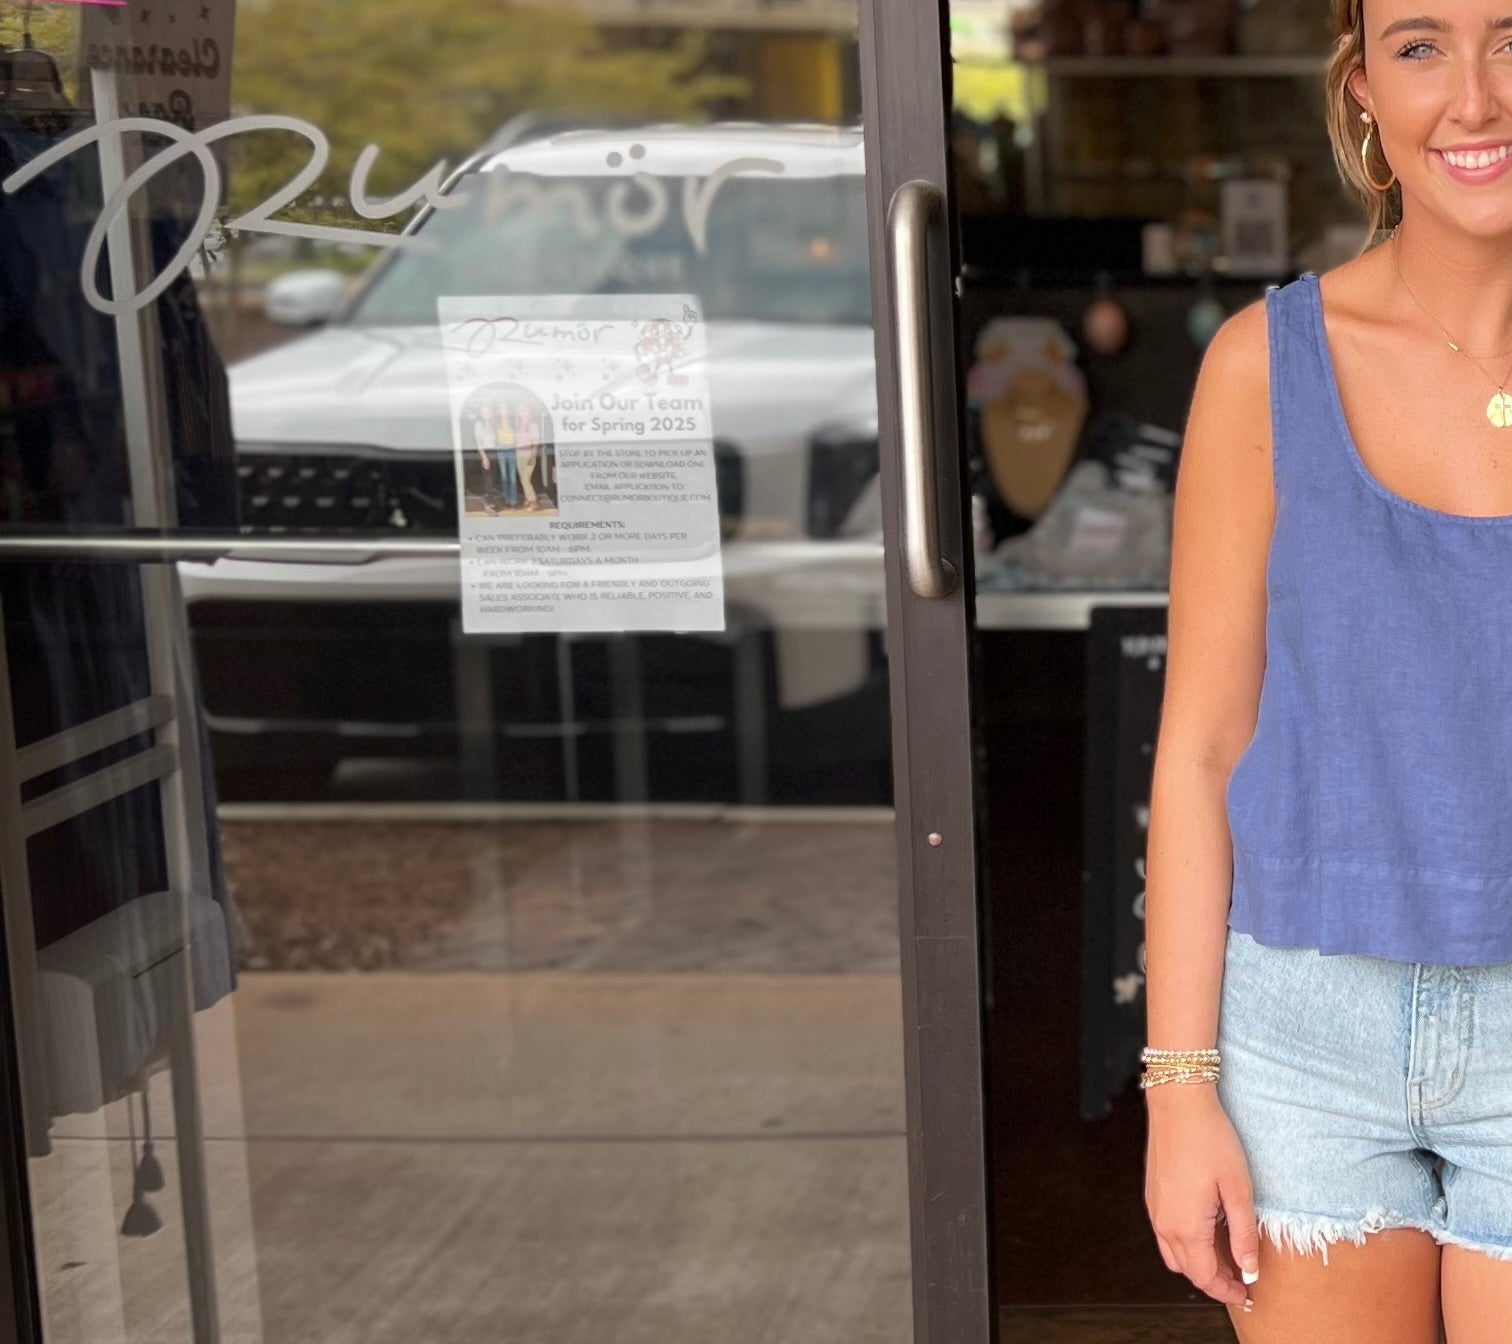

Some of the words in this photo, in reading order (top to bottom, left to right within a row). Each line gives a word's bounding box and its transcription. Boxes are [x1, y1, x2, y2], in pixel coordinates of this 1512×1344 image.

[3, 114, 786, 316] Rumör
[450, 315, 616, 359] Rumör
[551, 394, 594, 412] Join
[599, 392, 639, 412] Our
[645, 392, 703, 411] Team
[562, 417, 585, 432] for
[591, 417, 645, 436] Spring
[650, 417, 697, 432] 2025
[559, 449, 582, 457] STOP
[583, 449, 594, 457] BY
[597, 449, 613, 457] THE
[616, 449, 641, 457] STORE
[644, 449, 656, 457] TO
[658, 449, 679, 457] PICK
[680, 449, 693, 457] UP
[694, 449, 707, 457] AN
[561, 460, 618, 468] APPLICATION
[620, 460, 633, 468] OR
[634, 460, 686, 468] DOWNLOAD
[687, 460, 705, 468] ONE
[590, 471, 617, 479] FROM
[618, 471, 638, 479] OUR
[584, 483, 611, 491] EMAIL
[613, 483, 670, 491] APPLICATION
[549, 521, 626, 529] REQUIREMENTS:
[475, 534, 495, 542] CAN
[497, 534, 556, 542] PREFERABLY
[559, 533, 588, 541] WORK
[598, 533, 612, 541] OR
[614, 532, 640, 540] MORE
[644, 532, 668, 540] DAYS
[670, 532, 688, 540] PER
[476, 546, 503, 554] WEEK
[505, 545, 533, 553] FROM
[539, 557, 593, 565] SATURDAYS
[604, 556, 640, 564] MONTH
[516, 581, 559, 589] LOOKING
[560, 581, 580, 589] FOR
[591, 580, 636, 588] FRIENDLY
[660, 579, 711, 587] OUTGOING
[510, 593, 561, 601] ASSOCIATE
[564, 593, 588, 601] WHO
[694, 591, 713, 599] AND
